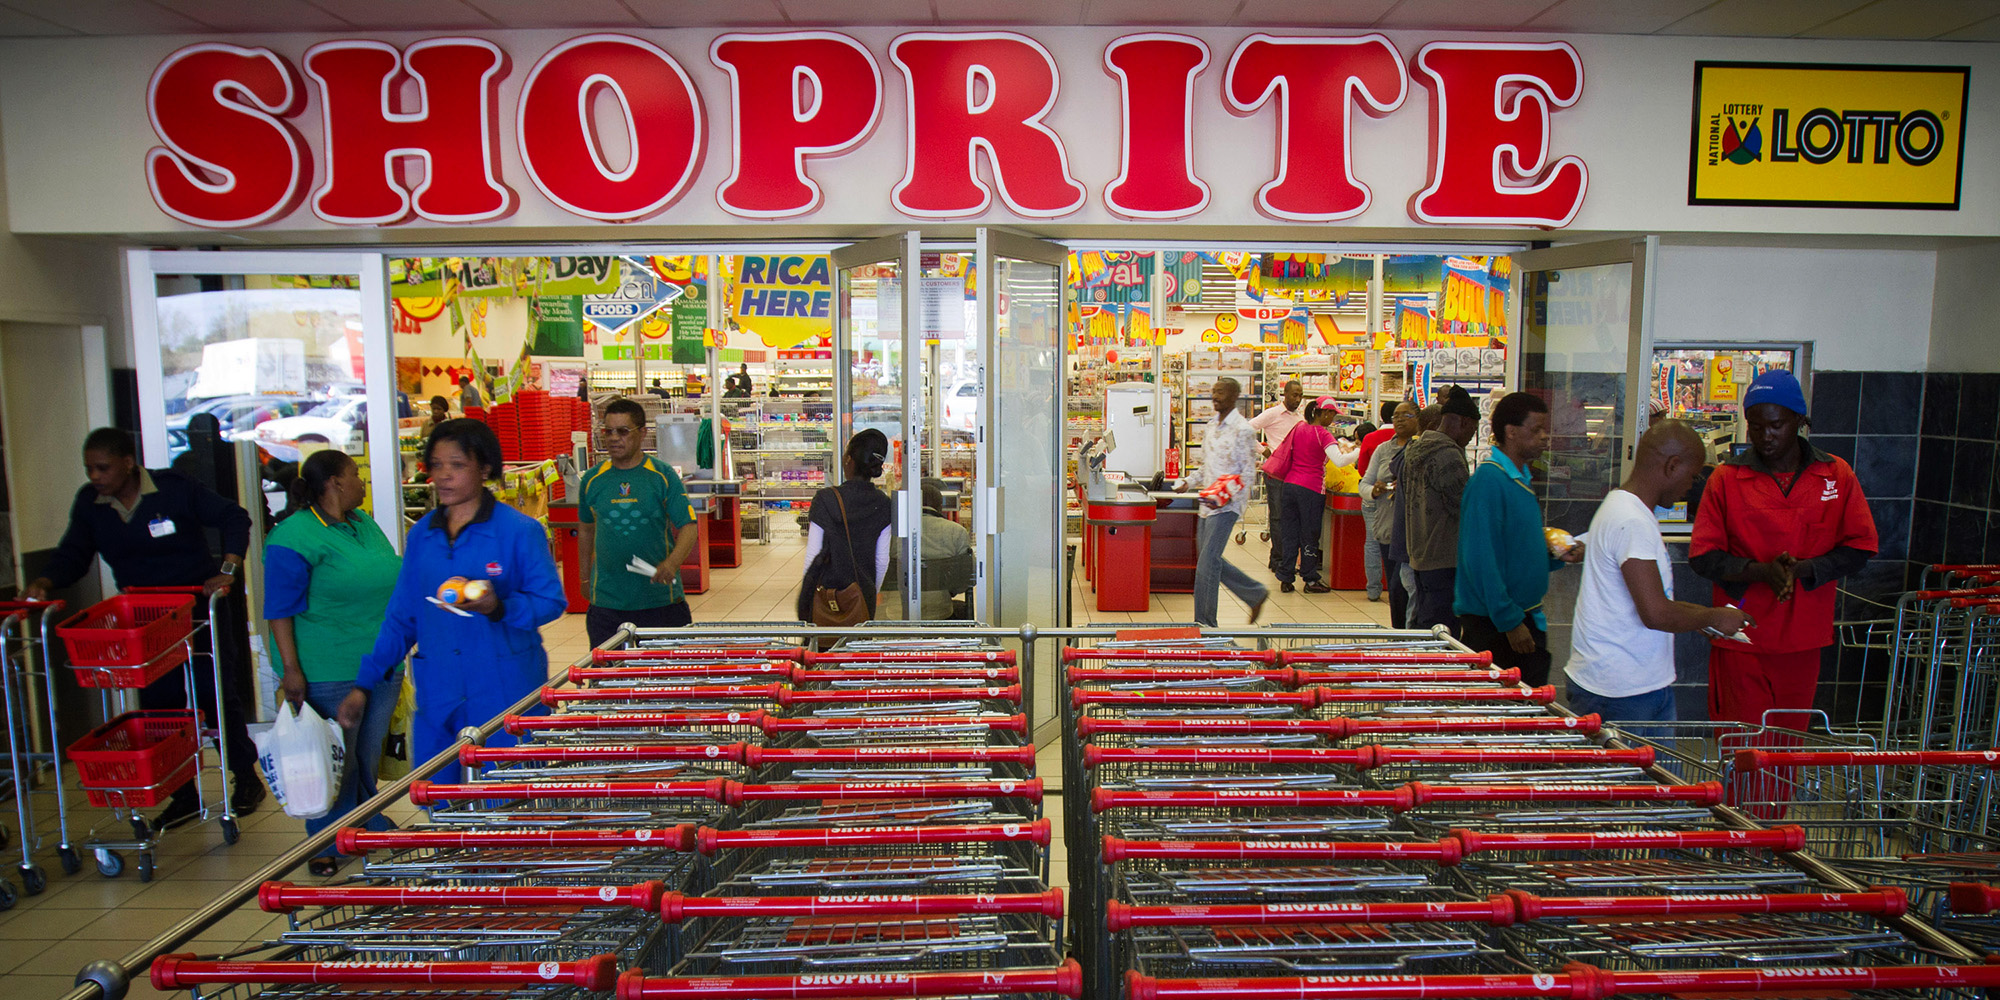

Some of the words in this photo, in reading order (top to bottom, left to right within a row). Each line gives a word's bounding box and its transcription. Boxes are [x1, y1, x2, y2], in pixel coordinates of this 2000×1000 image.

[1723, 104, 1764, 116] LOTTERY
[145, 30, 1589, 229] SHOPRITE
[1708, 112, 1721, 166] NATIONAL
[1770, 108, 1945, 166] LOTTO
[554, 256, 611, 281] Day
[740, 256, 831, 285] RICA
[590, 304, 632, 314] FOODS
[739, 289, 831, 317] HERE
[1443, 273, 1488, 323] BULK
[1416, 364, 1424, 388] PRICES
[1660, 366, 1668, 390] PRICES
[1416, 388, 1426, 408] OWER
[1268, 903, 1363, 911] SHOPRITE
[800, 973, 910, 984] SHOPRITE
[1306, 975, 1416, 983] SHOPRITE
[1763, 966, 1868, 976] SHOPRITE
